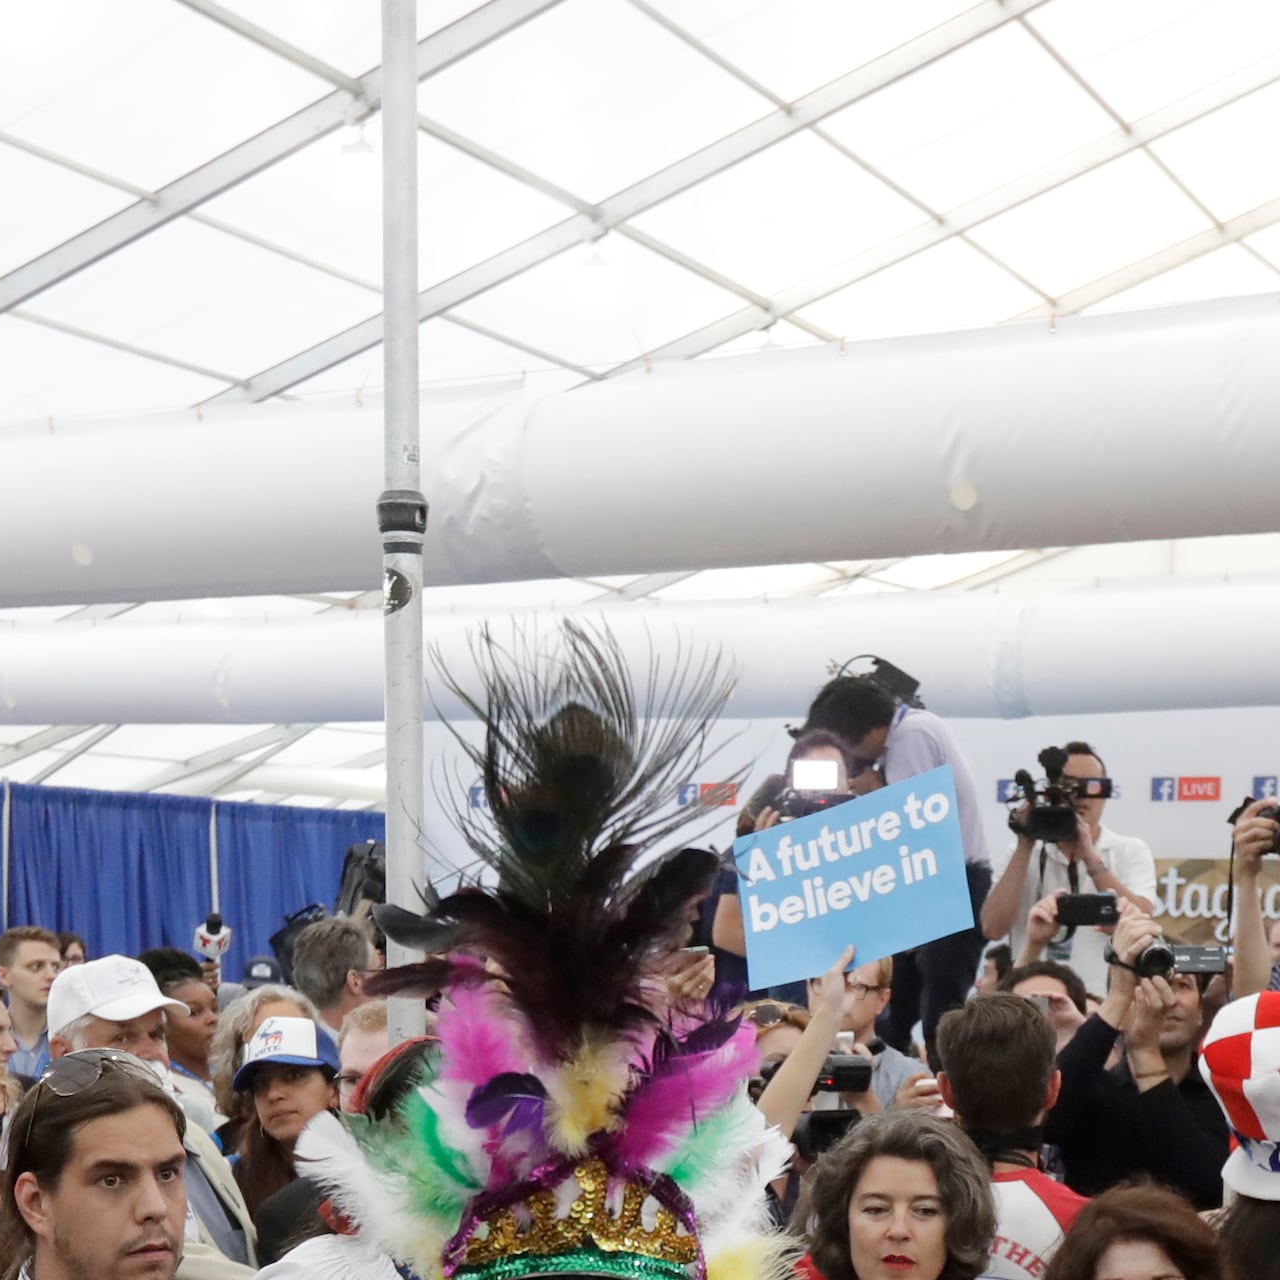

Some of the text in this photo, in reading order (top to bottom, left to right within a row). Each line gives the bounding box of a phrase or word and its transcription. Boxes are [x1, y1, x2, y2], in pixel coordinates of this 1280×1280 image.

[1183, 782, 1215, 796] LIVE
[746, 792, 950, 887] A future to
[748, 845, 938, 933] believe in
[990, 1235, 1047, 1278] THE
